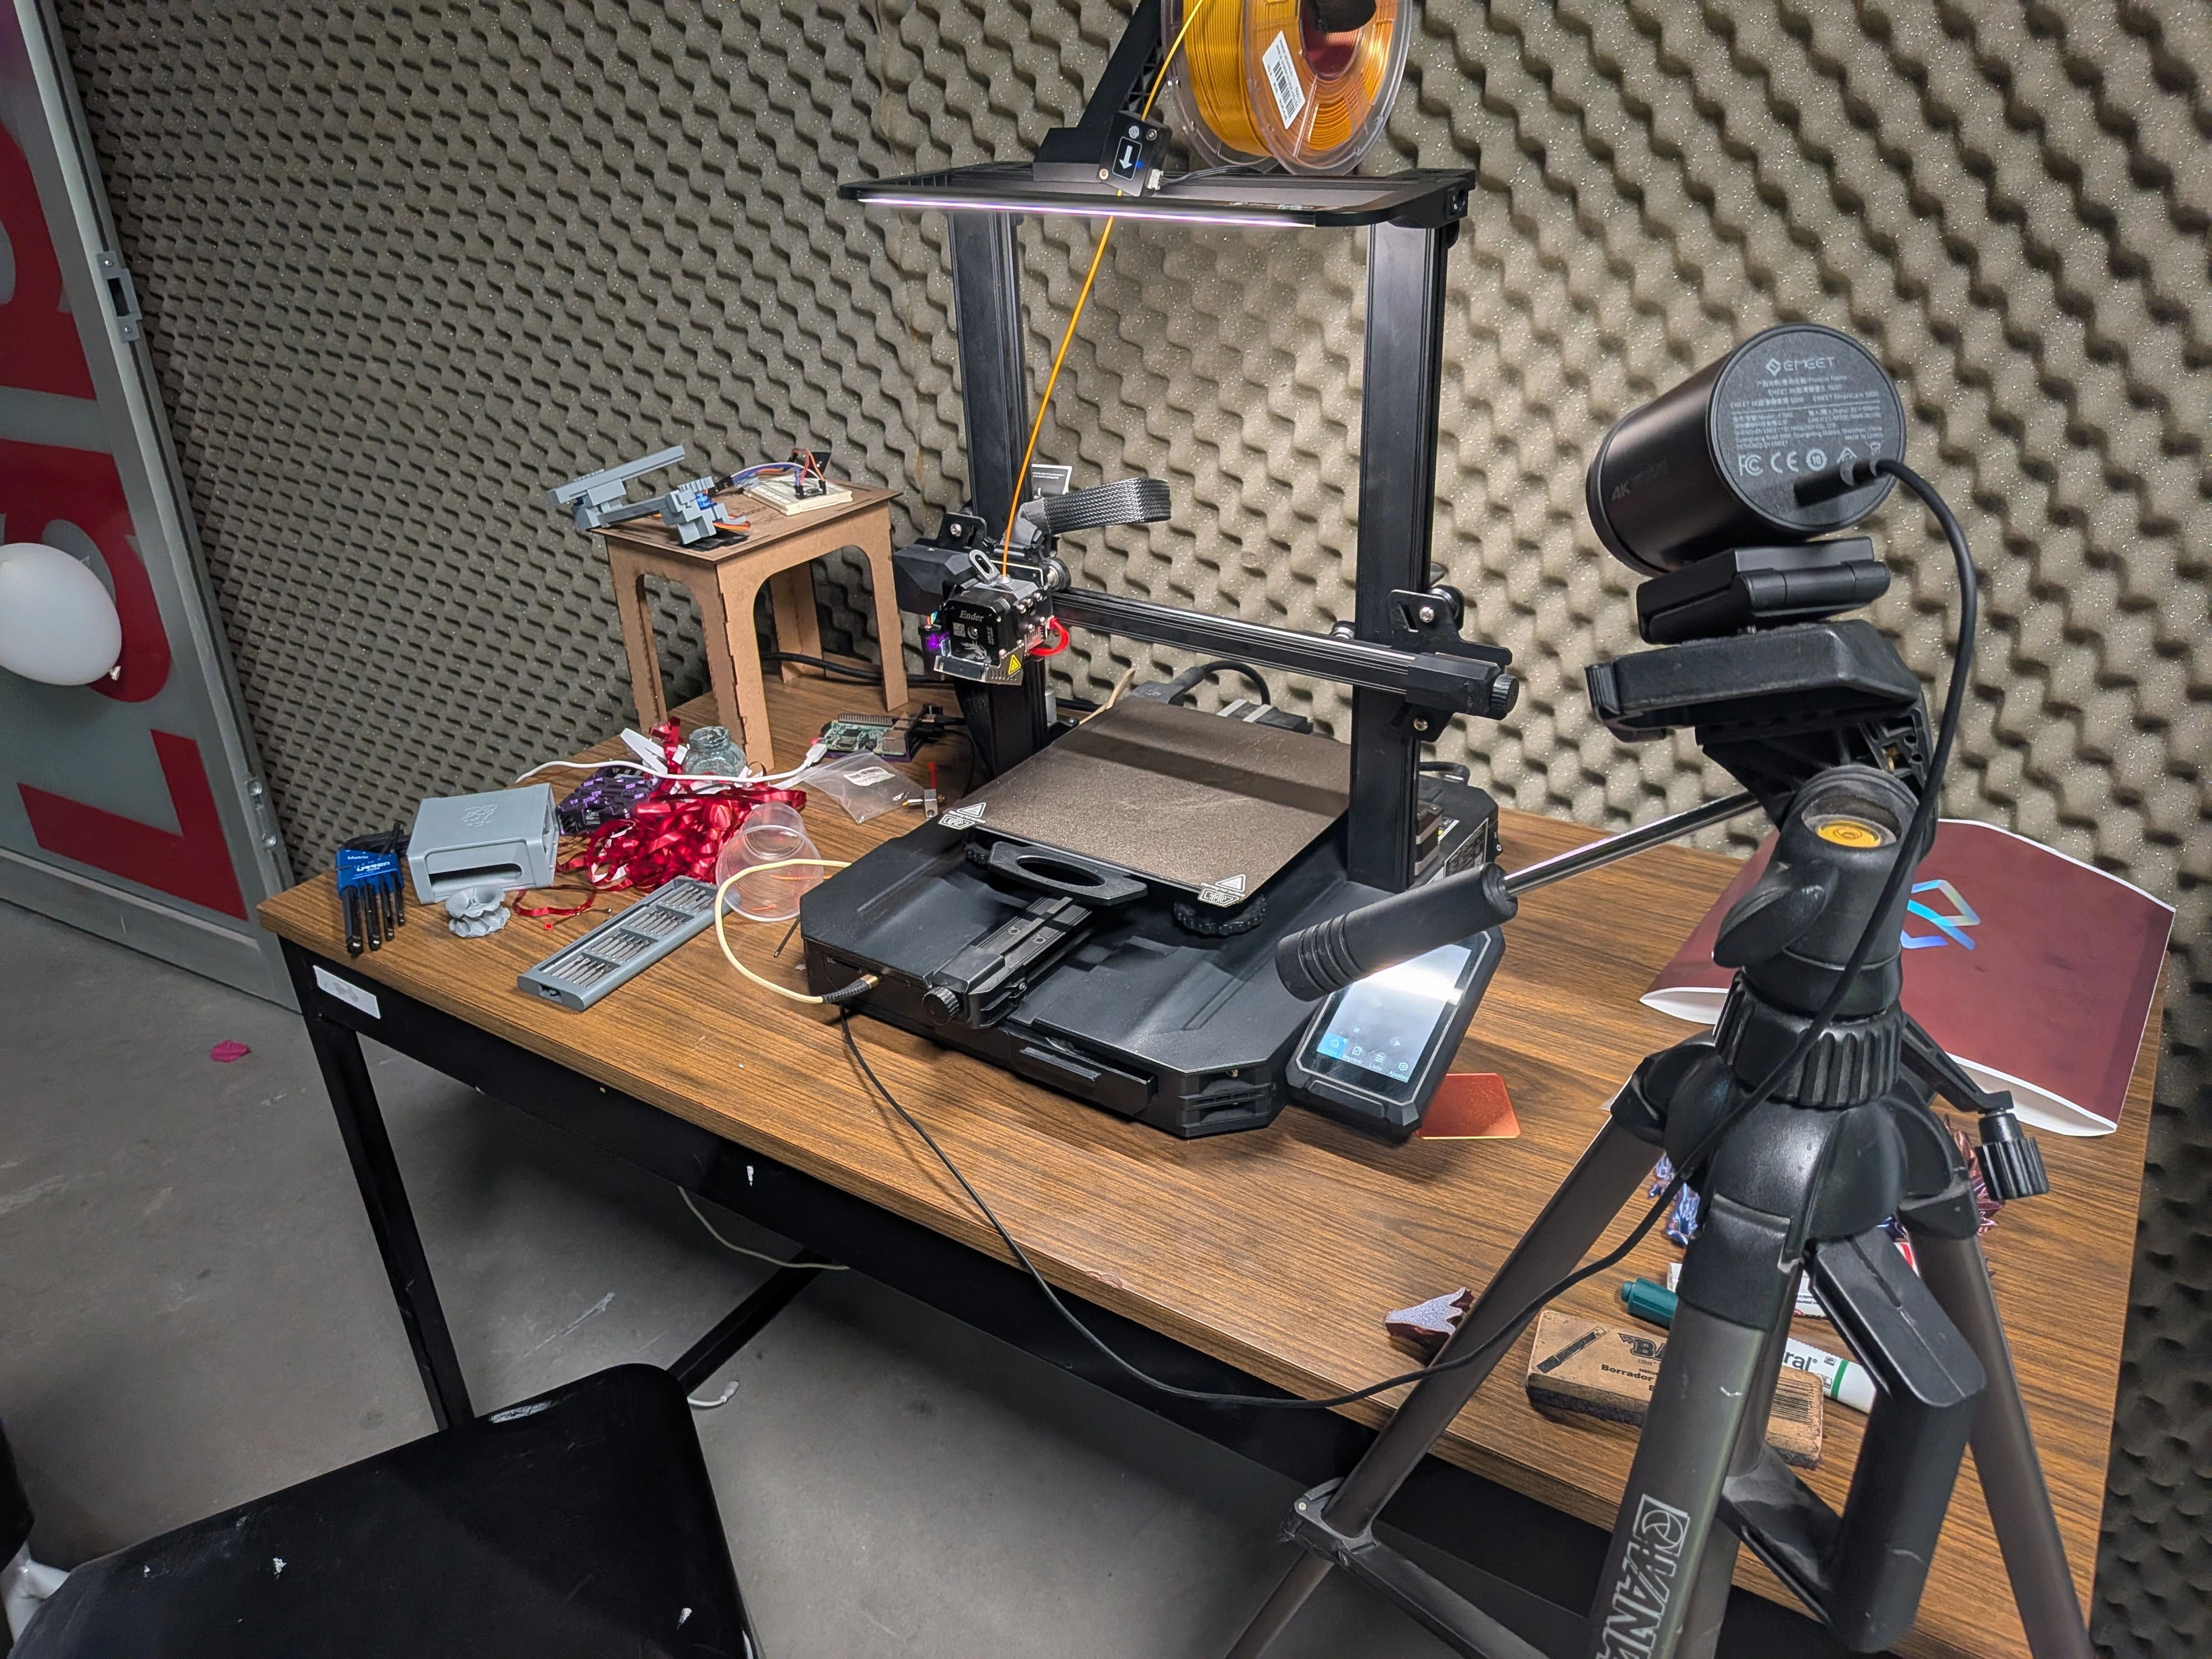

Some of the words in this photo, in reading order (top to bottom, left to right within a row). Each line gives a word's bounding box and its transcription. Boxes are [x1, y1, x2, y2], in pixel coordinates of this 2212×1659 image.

[959, 610, 984, 622] Ender
[1342, 1054, 1364, 1065] Imprimir
[1368, 1062, 1383, 1072] Listo
[1389, 1070, 1409, 1081] Ajustes
[1601, 1364, 1653, 1382] Borrador
